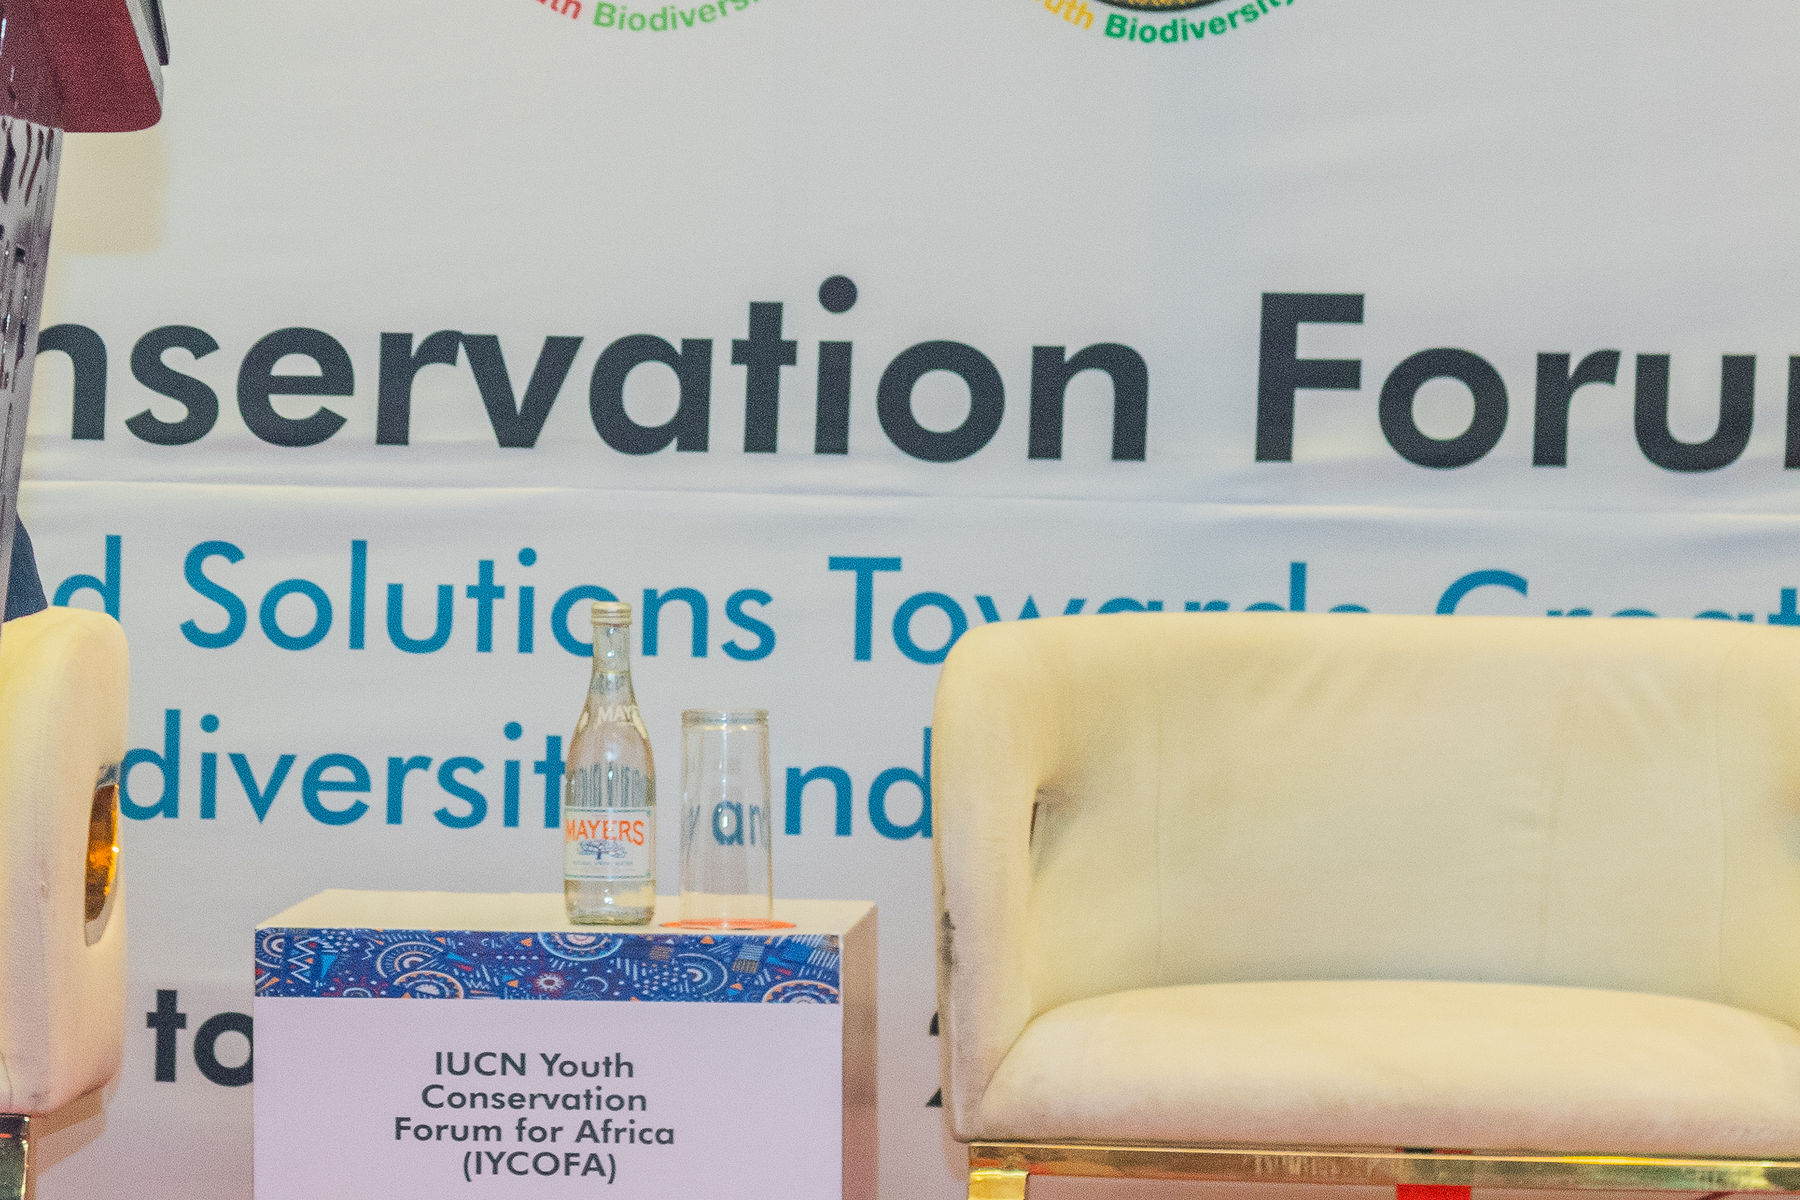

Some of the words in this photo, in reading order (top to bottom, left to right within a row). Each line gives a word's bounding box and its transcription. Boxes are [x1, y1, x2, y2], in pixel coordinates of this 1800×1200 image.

[1255, 293, 1800, 473] Foru
[180, 539, 776, 664] Solutions
[566, 819, 646, 846] MAYERS
[436, 1052, 526, 1076] IUCN
[540, 1053, 633, 1077] Youth
[422, 1084, 646, 1111] Conservation
[396, 1117, 501, 1141] Forum
[516, 1117, 563, 1143] for
[575, 1119, 674, 1144] Africa
[464, 1151, 616, 1184] (IYCOFA)
